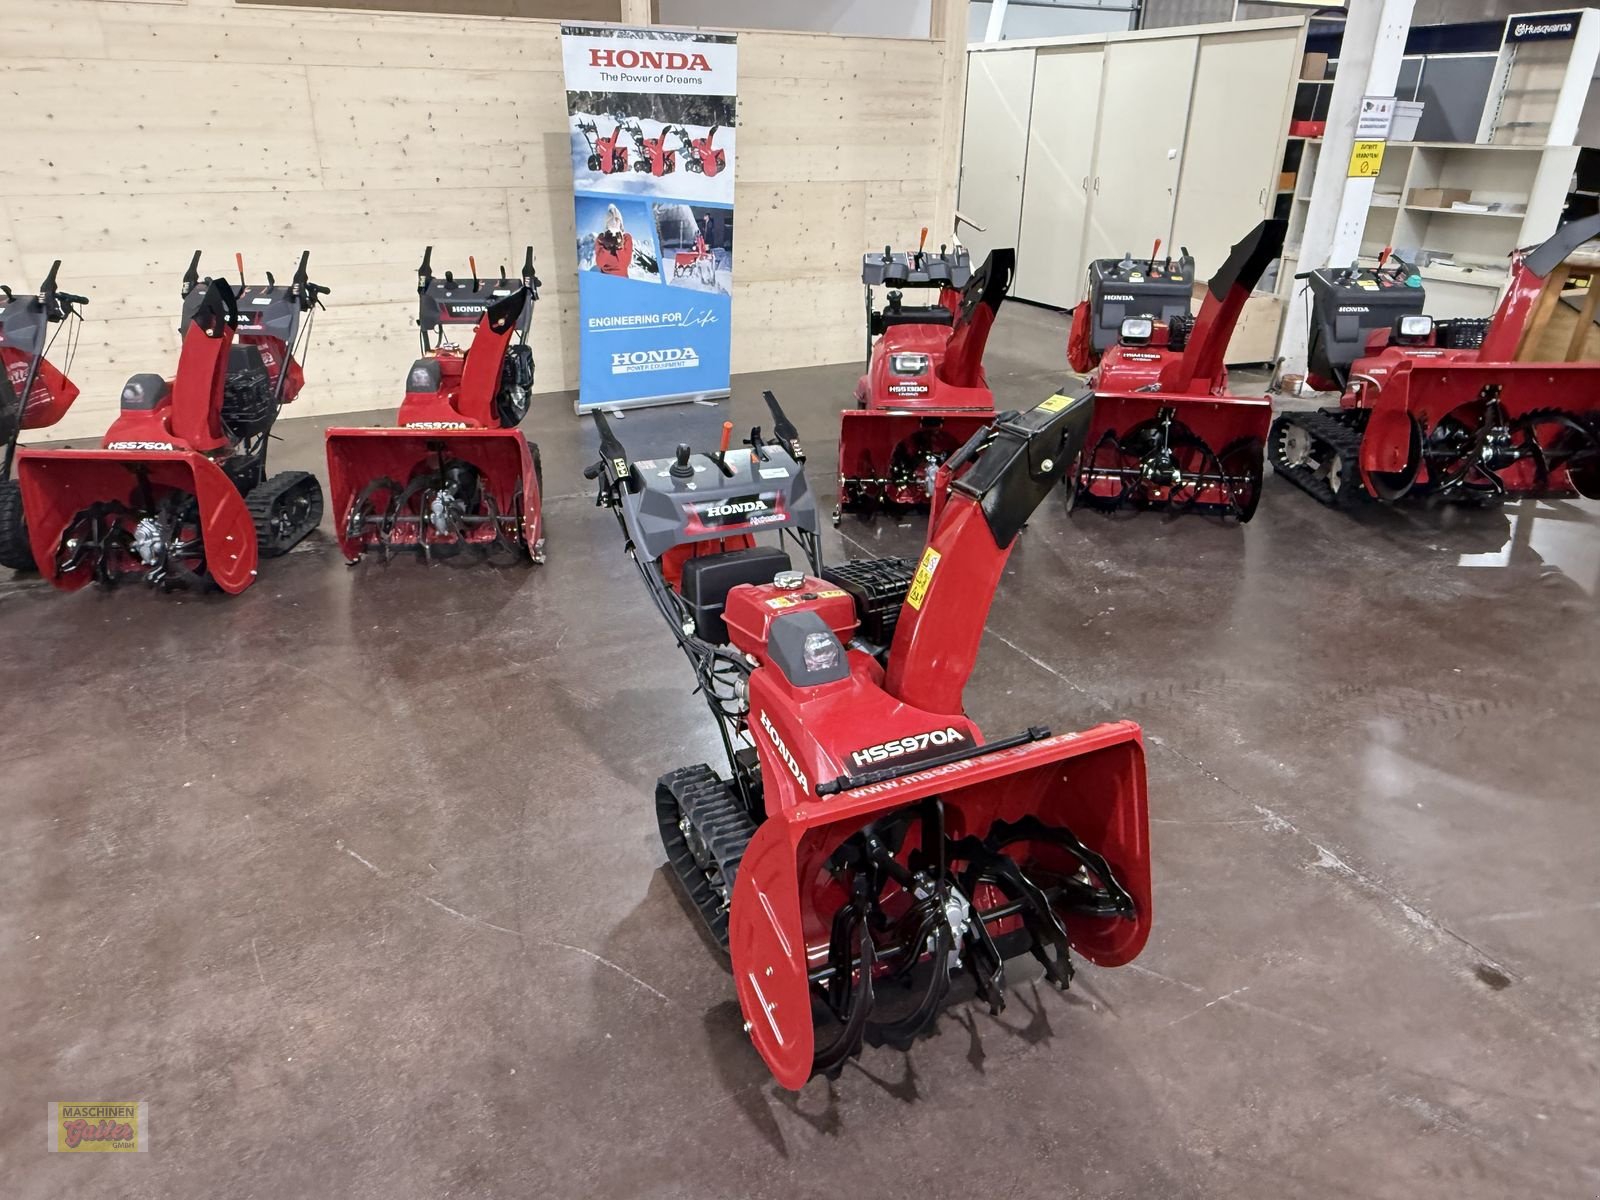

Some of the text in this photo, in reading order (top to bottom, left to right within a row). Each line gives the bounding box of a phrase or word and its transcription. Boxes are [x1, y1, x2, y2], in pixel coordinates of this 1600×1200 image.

[589, 49, 712, 71] HONDA
[600, 72, 703, 85] The Power of Dreams
[588, 314, 660, 328] ENGINEERING
[662, 312, 682, 323] FOR
[611, 347, 699, 366] HONDA
[108, 441, 173, 451] HSS760A
[707, 500, 768, 517] HONDA
[760, 709, 810, 796] HONDA
[852, 727, 965, 767] HSS970A
